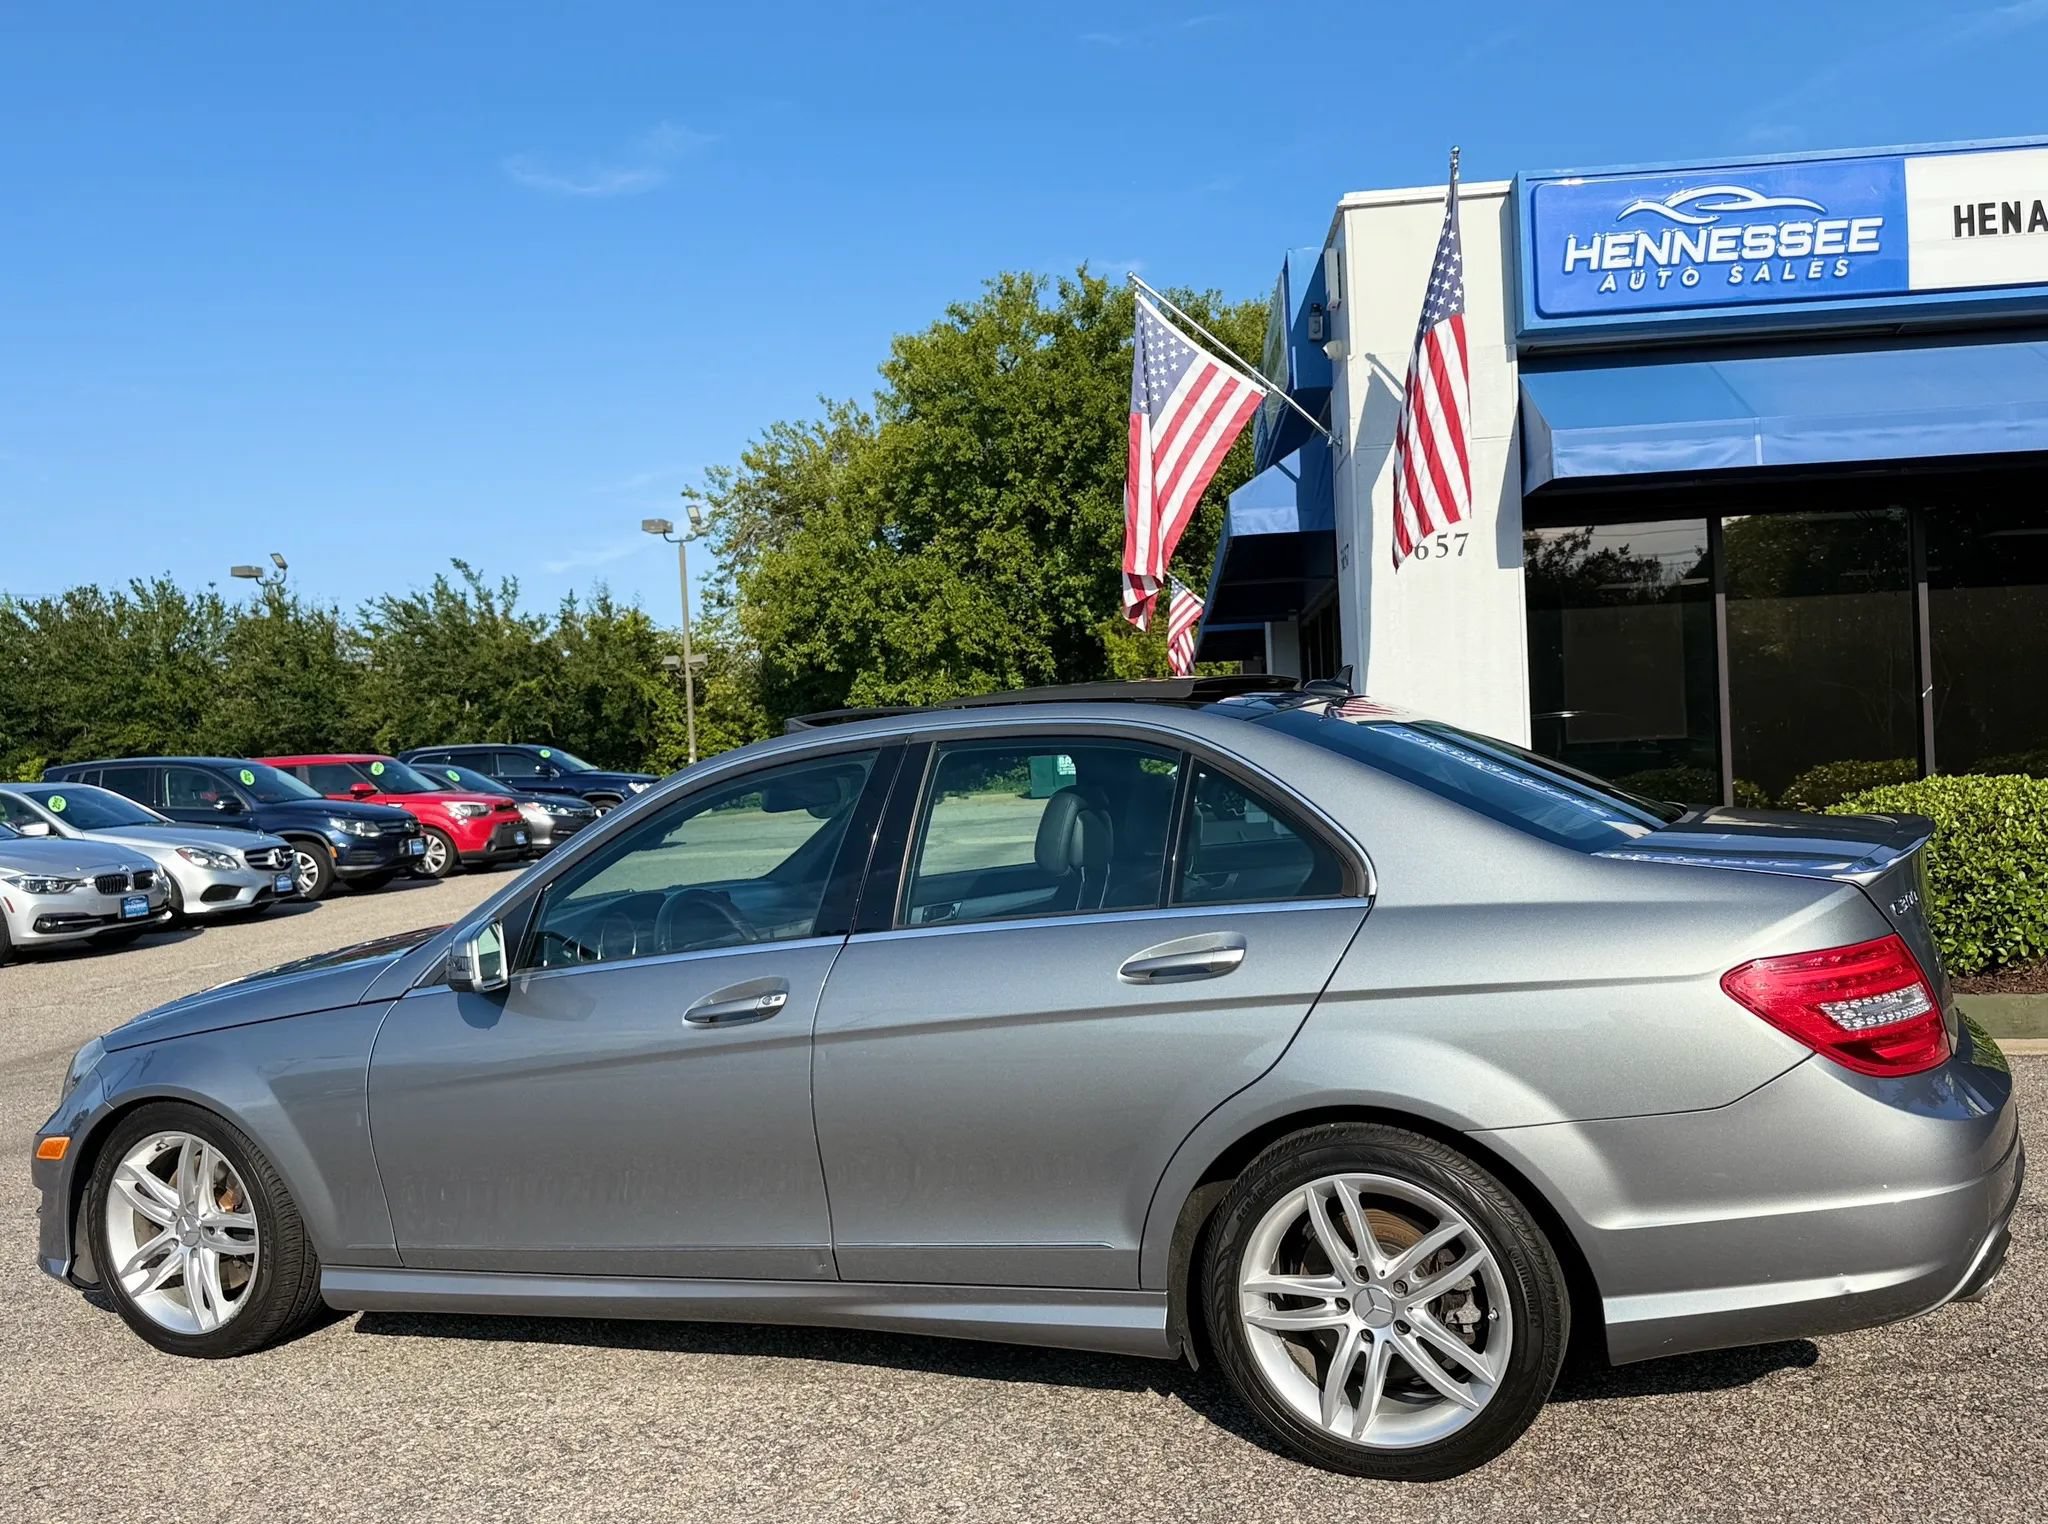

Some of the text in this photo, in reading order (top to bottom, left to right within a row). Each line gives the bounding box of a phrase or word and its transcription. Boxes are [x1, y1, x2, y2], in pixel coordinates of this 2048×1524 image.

[1953, 199, 2048, 238] HENA
[1563, 216, 1885, 273] HENNESSEE
[1599, 256, 1850, 293] AUTO SALES
